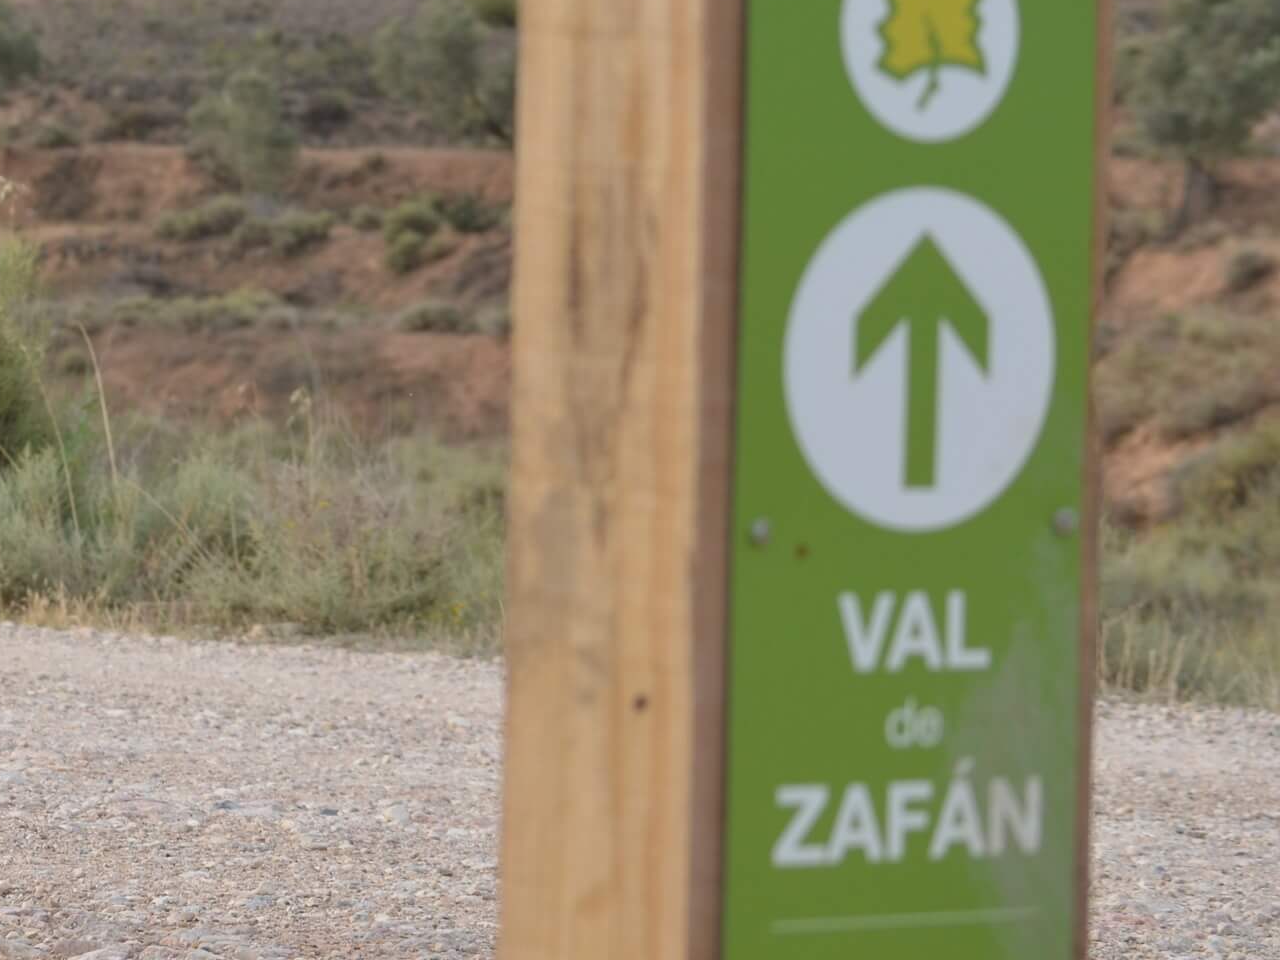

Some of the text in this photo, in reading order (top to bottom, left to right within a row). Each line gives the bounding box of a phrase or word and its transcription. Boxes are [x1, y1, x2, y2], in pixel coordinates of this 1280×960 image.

[837, 590, 991, 673] VAL
[885, 697, 944, 748] de
[771, 757, 1043, 868] ZAFÁN
